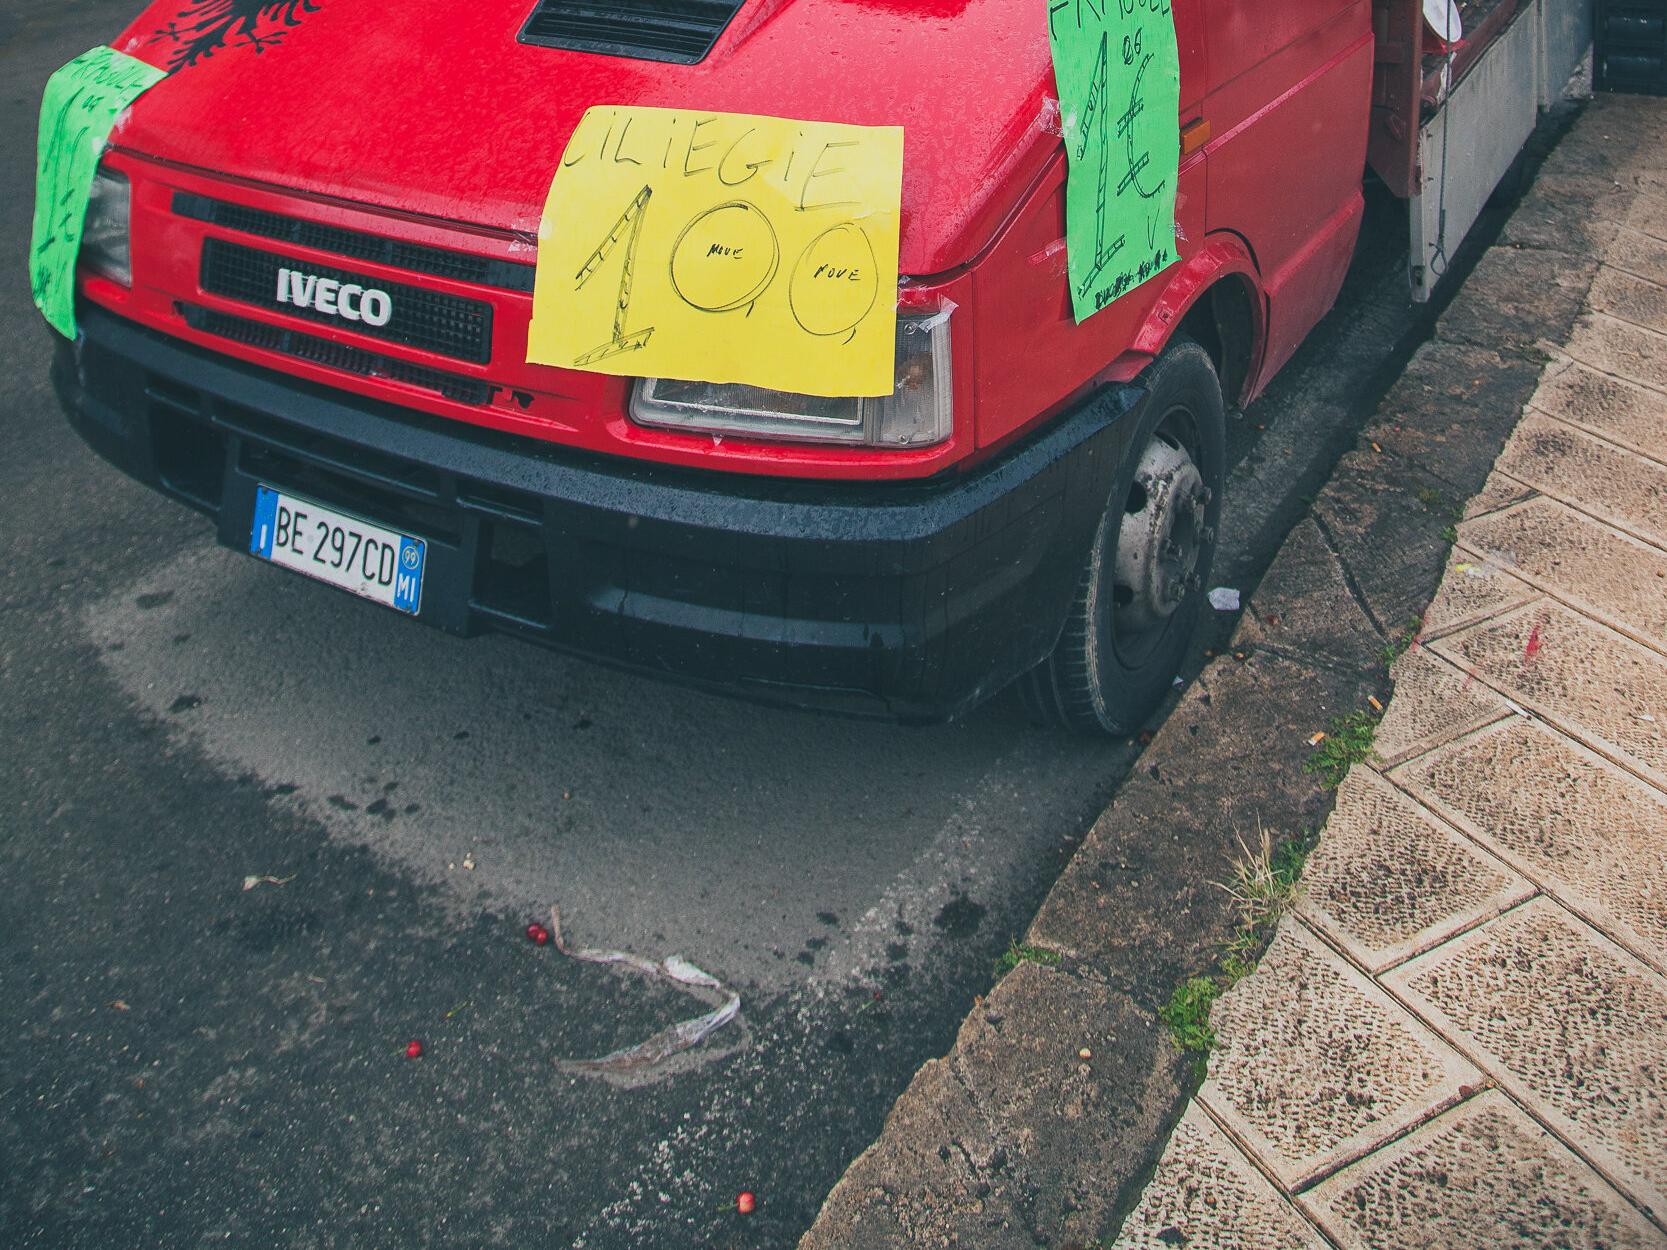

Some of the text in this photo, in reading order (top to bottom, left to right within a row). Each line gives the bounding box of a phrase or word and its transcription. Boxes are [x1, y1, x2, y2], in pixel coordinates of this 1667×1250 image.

[562, 111, 861, 211] CILIEGIE
[276, 267, 392, 327] IVECO
[396, 572, 416, 603] MI
